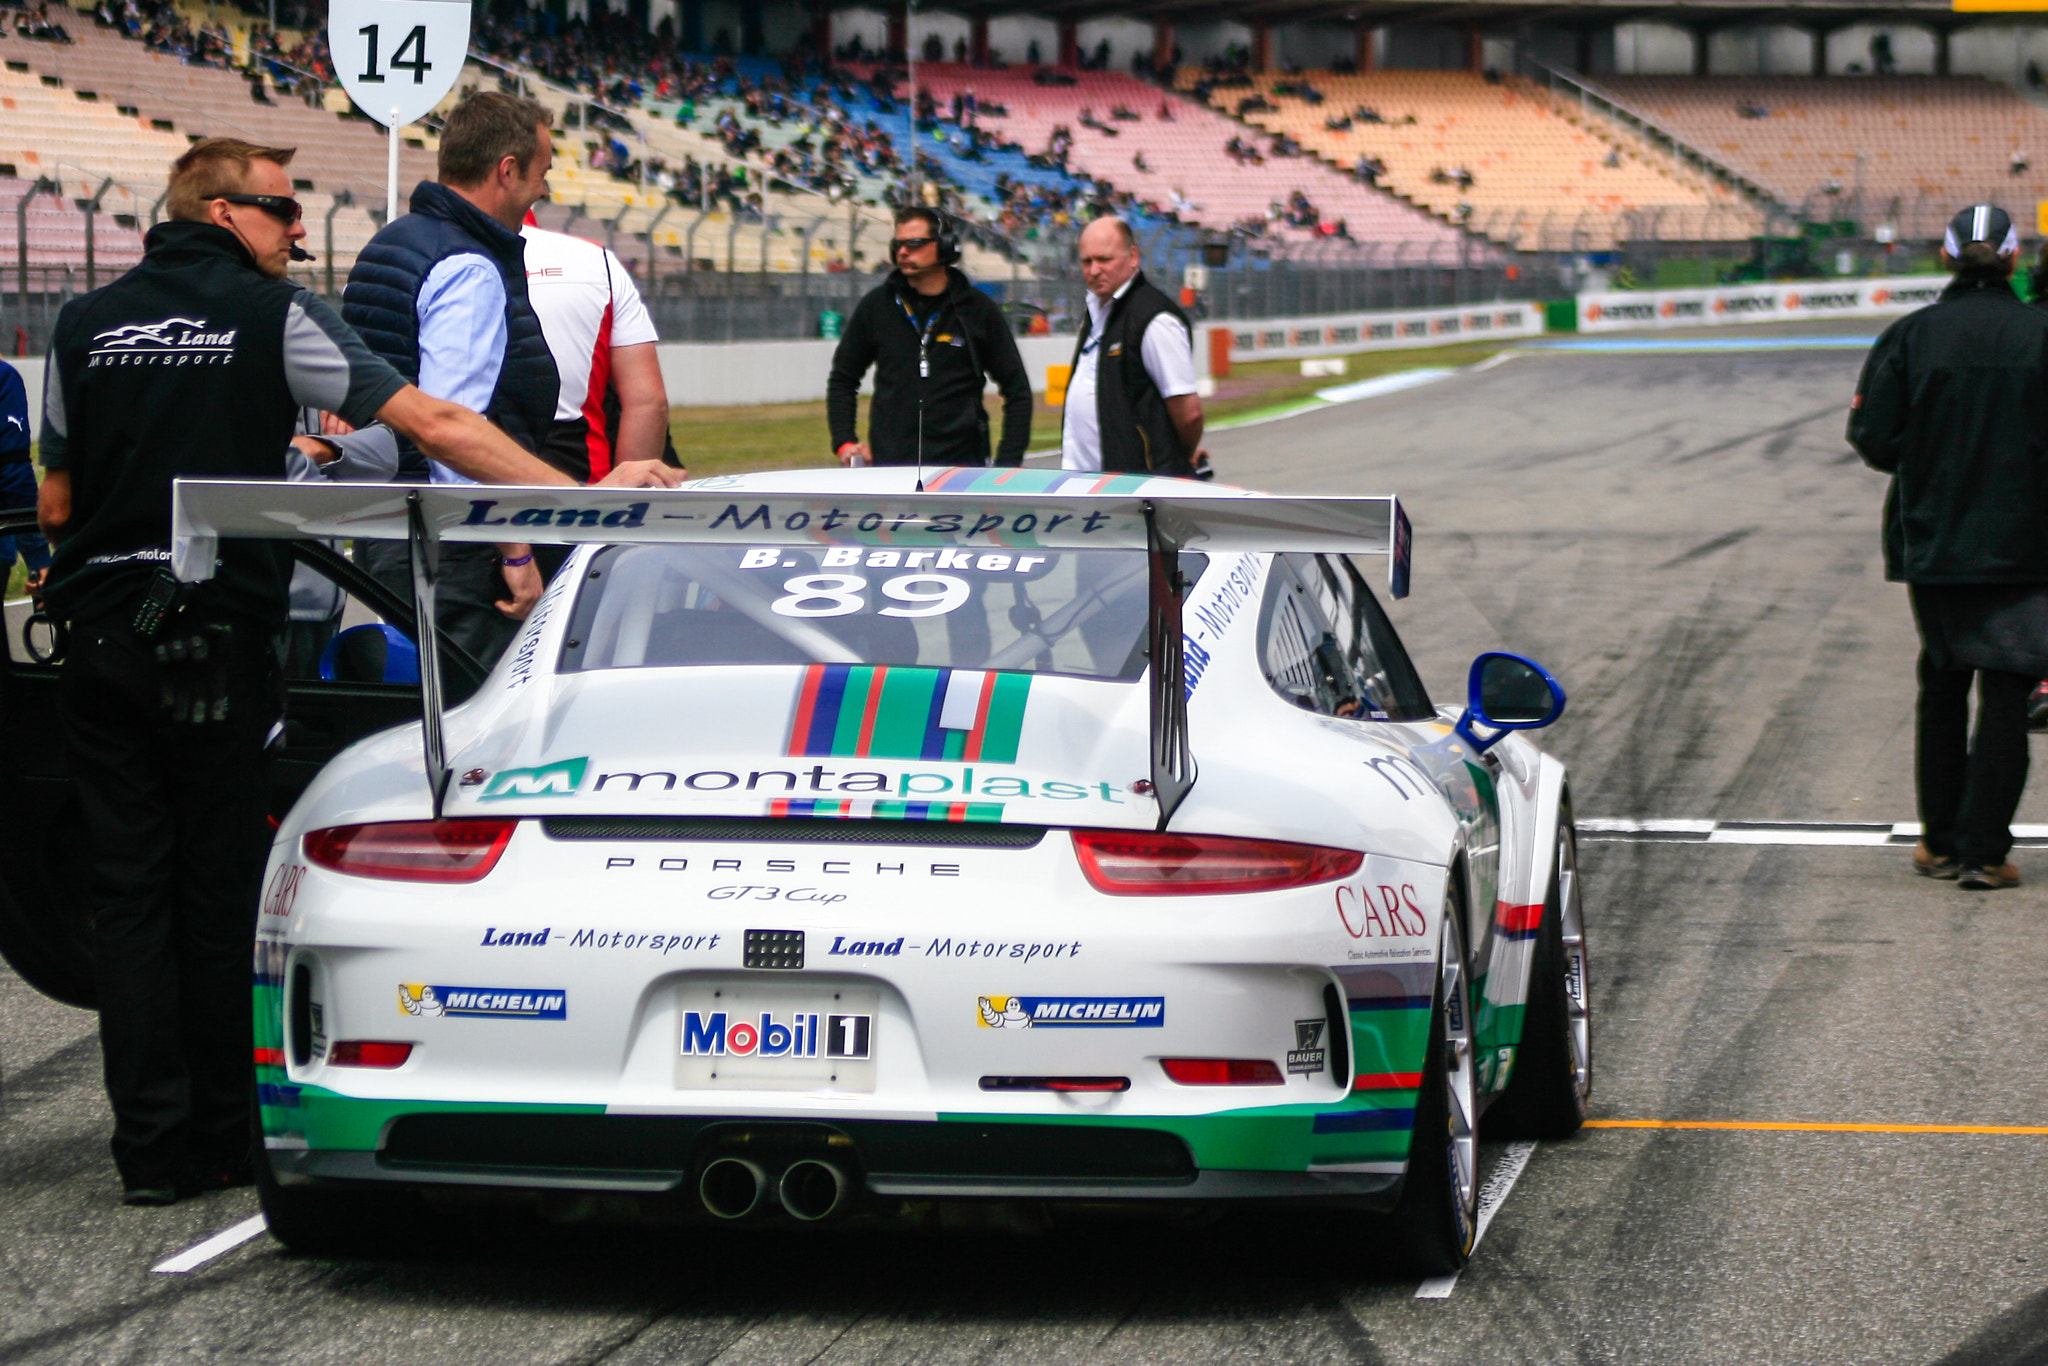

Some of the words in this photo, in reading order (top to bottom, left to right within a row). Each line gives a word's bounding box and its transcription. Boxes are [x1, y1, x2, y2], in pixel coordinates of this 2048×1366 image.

[358, 24, 432, 85] 14
[177, 330, 236, 346] Land
[88, 353, 233, 368] Motorsport
[460, 499, 650, 529] Land
[708, 504, 1112, 539] Motorsport
[738, 548, 797, 569] B.
[821, 547, 1046, 573] Barker
[770, 573, 970, 618] 89
[592, 765, 1126, 805] montaplast
[605, 857, 960, 877] PORSCHE
[264, 863, 307, 918] CARS
[707, 886, 780, 901] GT3
[785, 888, 847, 906] Cup
[1335, 883, 1426, 939] CARS
[480, 927, 551, 947] Land
[569, 928, 722, 956] Motorsport
[828, 937, 905, 956] Land
[925, 938, 1082, 964] Motorsport
[445, 993, 563, 1011] MICHELIN
[1033, 1003, 1162, 1019] MICHELIN
[680, 1010, 820, 1059] Mobil
[838, 1016, 857, 1057] 1
[1288, 1052, 1323, 1064] BAUER
